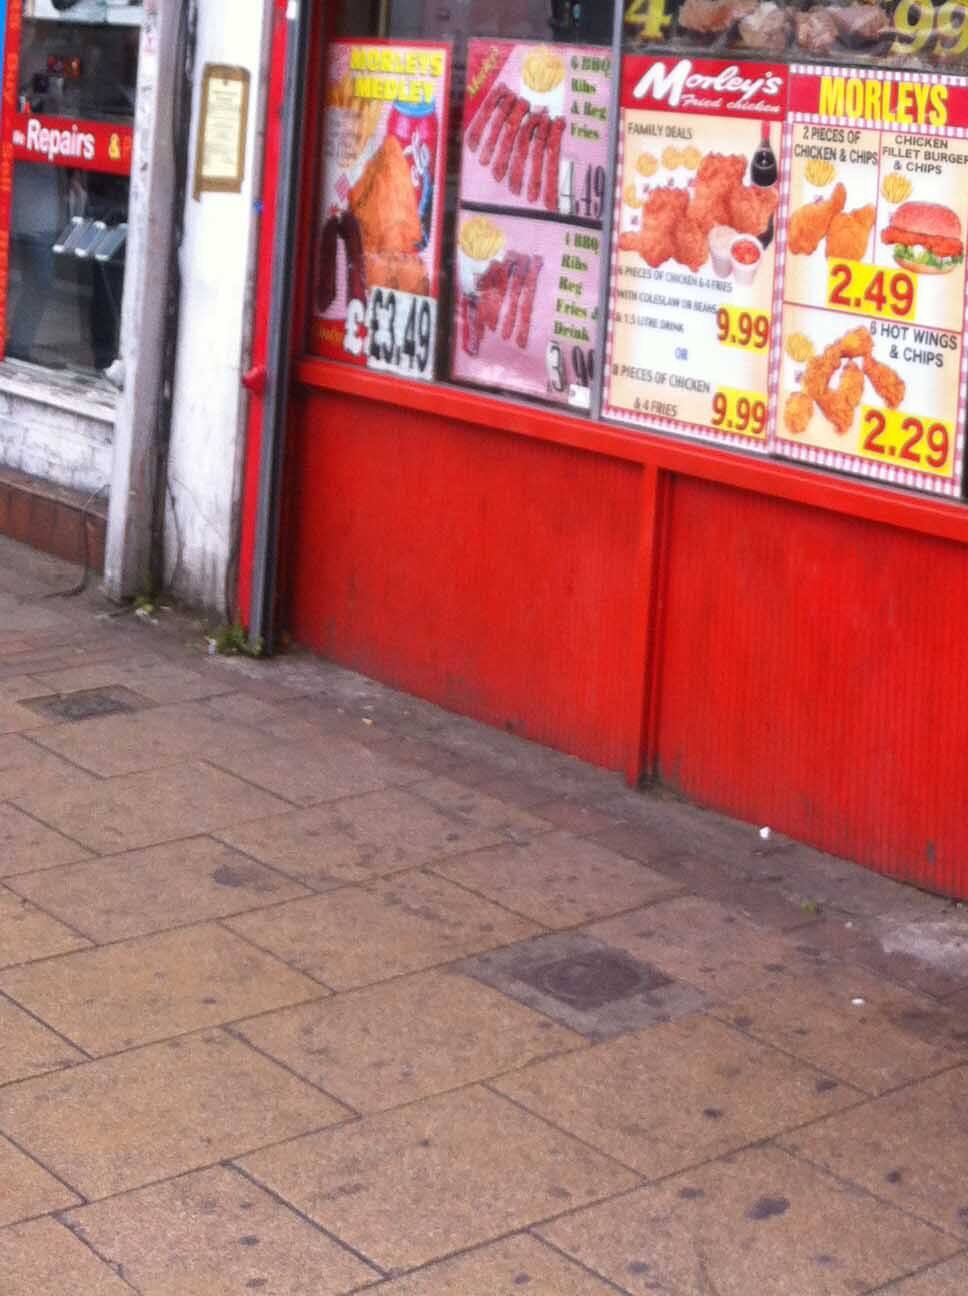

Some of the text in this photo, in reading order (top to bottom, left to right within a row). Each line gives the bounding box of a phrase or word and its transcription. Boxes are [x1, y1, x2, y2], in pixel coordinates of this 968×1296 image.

[350, 45, 443, 78] MORLEYS
[353, 76, 434, 105] MEDLEY
[633, 59, 784, 107] Morley's
[681, 93, 722, 108] Fried
[819, 76, 949, 127] MORLEYS
[26, 118, 95, 161] Repairs
[627, 122, 693, 140] FAMILY DEALS
[802, 126, 861, 144] 2 PIECES OF
[895, 135, 949, 150] CHICKEN
[794, 144, 878, 166] CHICKEN & CHIPS
[882, 146, 922, 160] FILLET
[893, 161, 943, 175] & CHIPS
[625, 265, 651, 279] PIECES
[665, 271, 697, 287] CHICKEN
[619, 288, 637, 301] WITH
[639, 290, 680, 308] COLESLAW
[828, 264, 915, 317] 2.49
[660, 319, 684, 333] DRINK
[717, 307, 769, 349] 9.99
[880, 324, 909, 340] HOT
[913, 329, 958, 350] WINGS
[889, 344, 944, 368] & CHIPS
[620, 364, 653, 383] PIECES
[654, 372, 667, 385] OF
[669, 374, 711, 393] CHICKEN
[651, 400, 678, 417] FRIES
[712, 392, 767, 434] 9.99
[863, 409, 950, 469] 2.29
